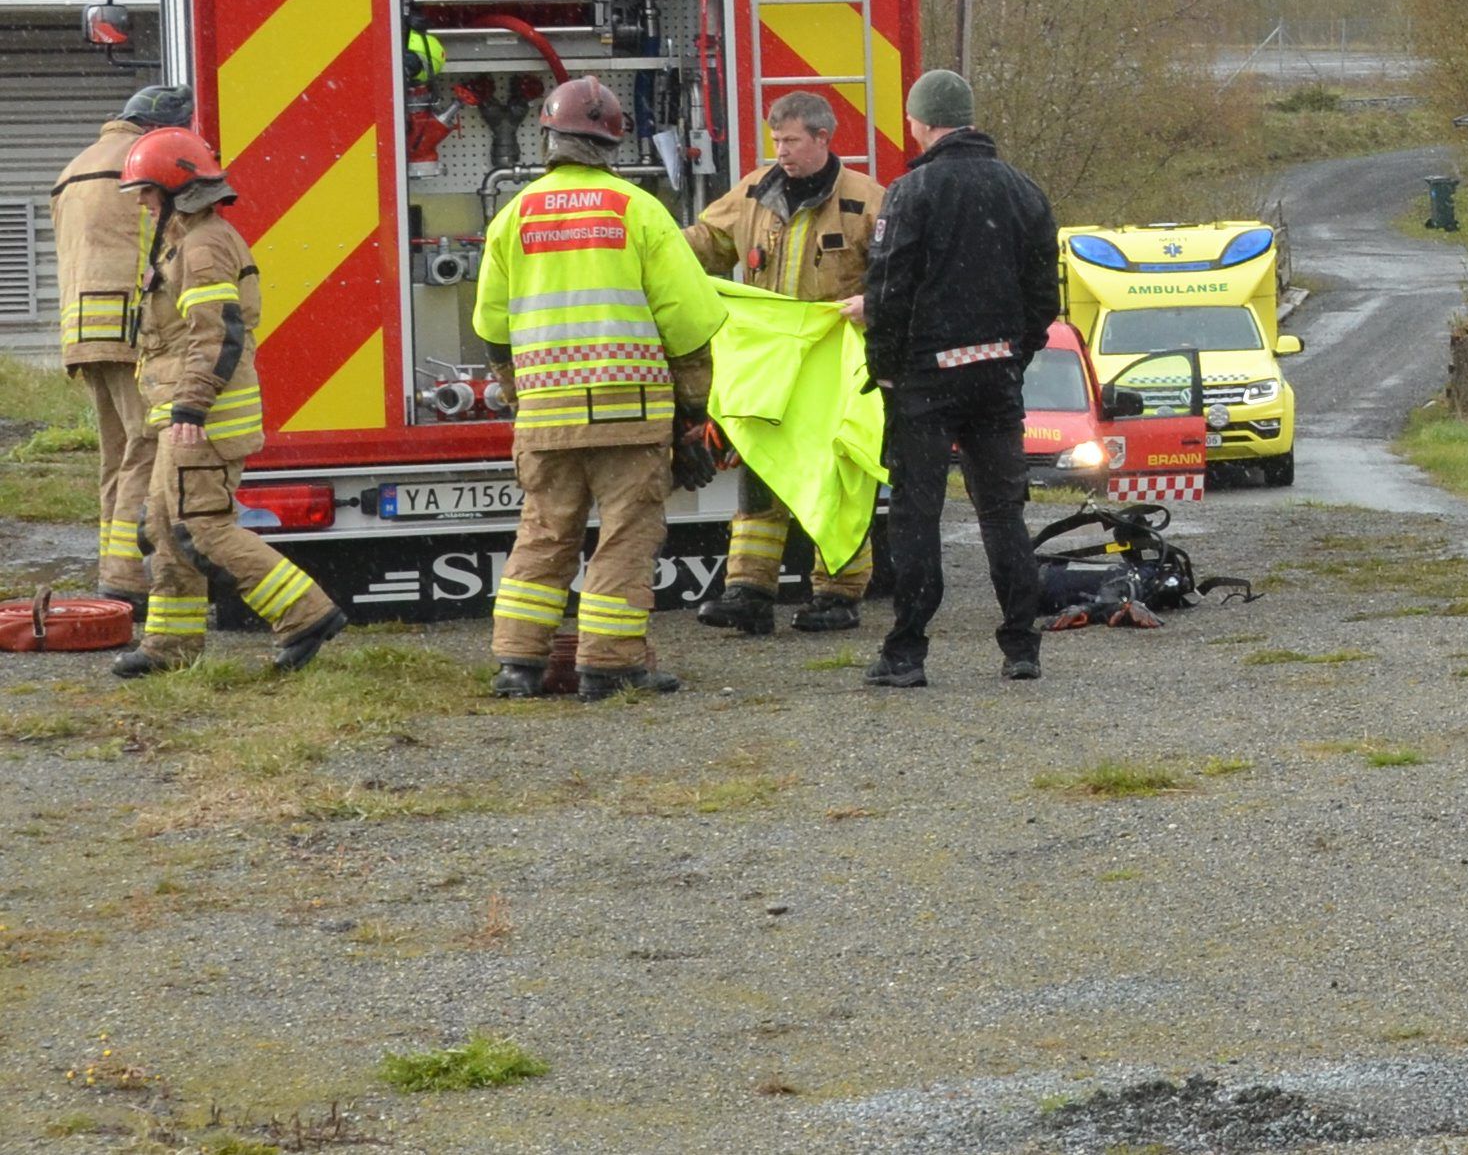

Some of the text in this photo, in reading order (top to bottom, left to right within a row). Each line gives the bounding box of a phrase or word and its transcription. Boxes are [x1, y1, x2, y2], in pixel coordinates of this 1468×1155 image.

[544, 192, 603, 210] BRANN
[522, 227, 625, 244] UTRYKNINGSLEDER
[1127, 283, 1229, 295] AMBULANSE
[1023, 427, 1062, 441] NING
[1148, 452, 1202, 466] BRANN
[406, 484, 526, 511] YA 71562
